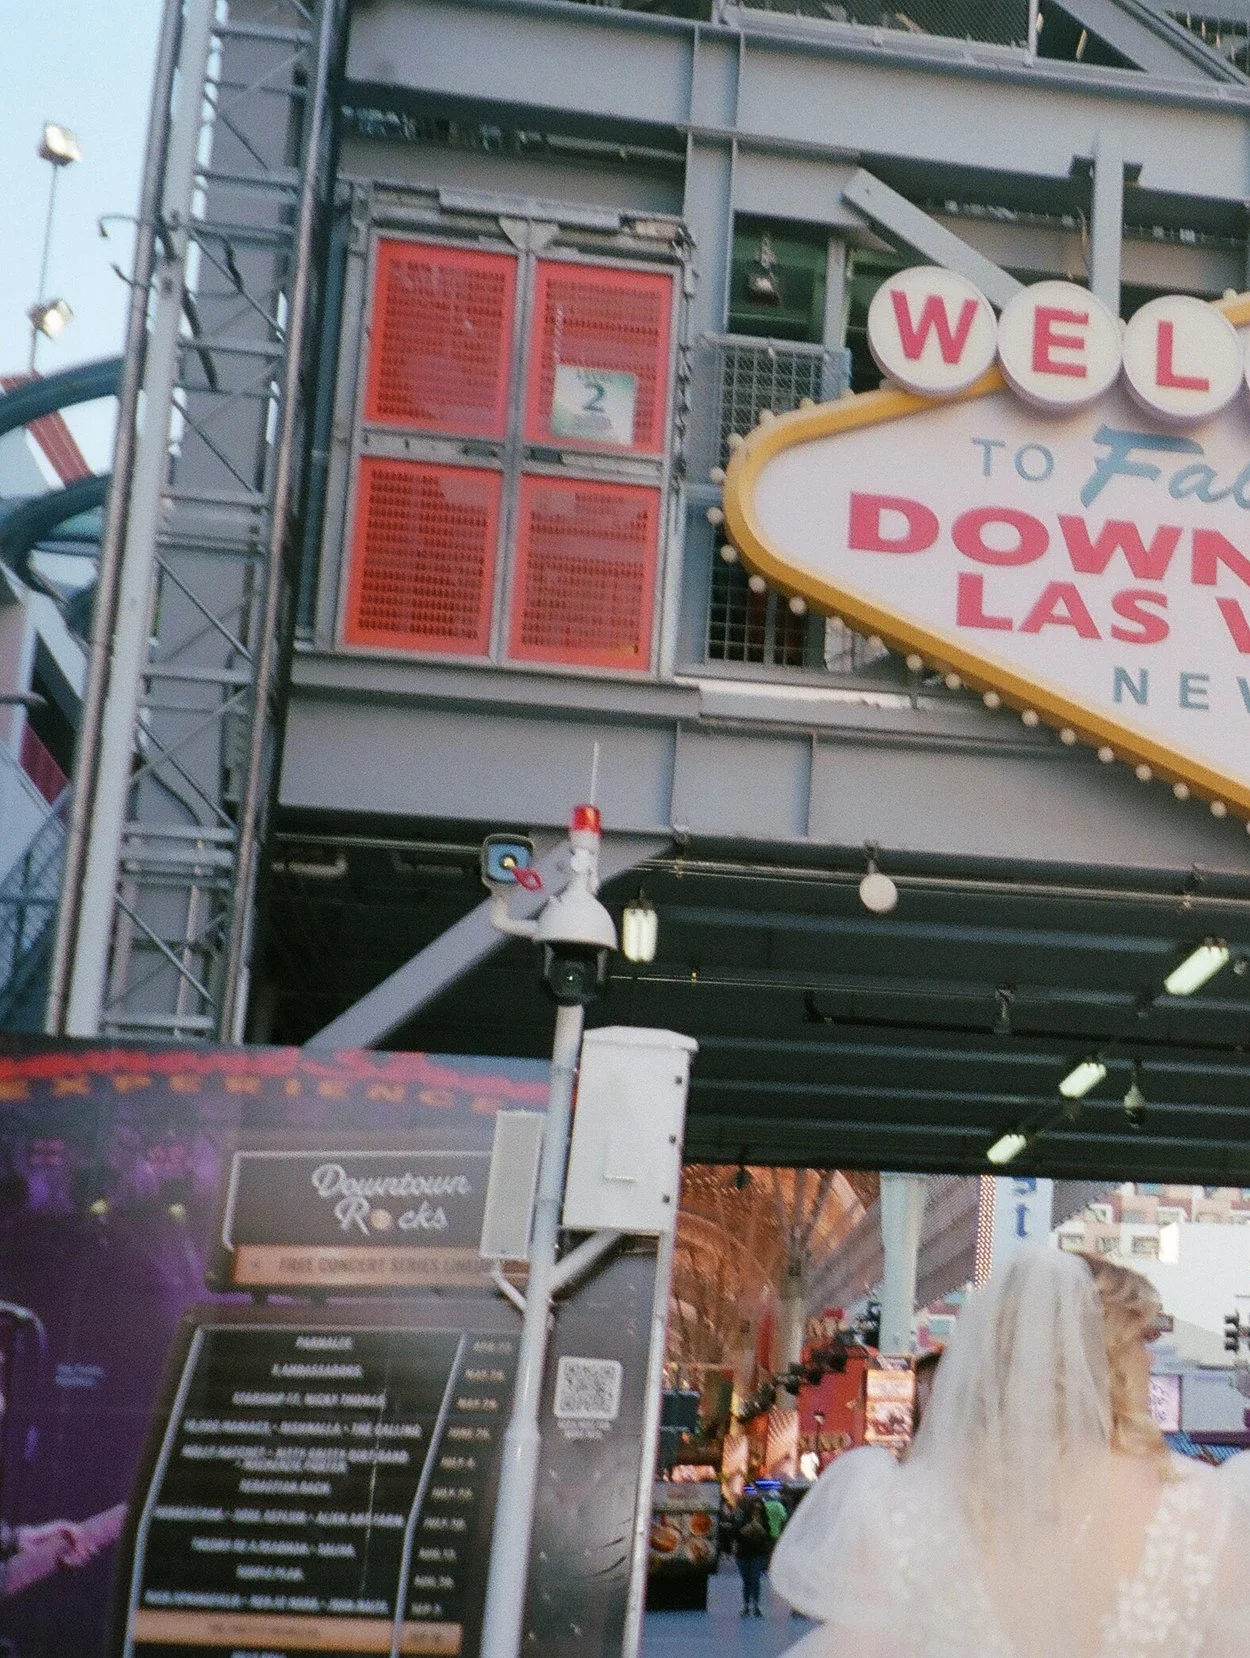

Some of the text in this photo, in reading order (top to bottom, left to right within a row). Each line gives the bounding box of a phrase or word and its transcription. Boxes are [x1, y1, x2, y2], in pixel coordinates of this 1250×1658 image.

[583, 381, 606, 412] 2
[972, 437, 1055, 482] TO
[955, 572, 1170, 645] LAS
[311, 1163, 471, 1198] Downtown
